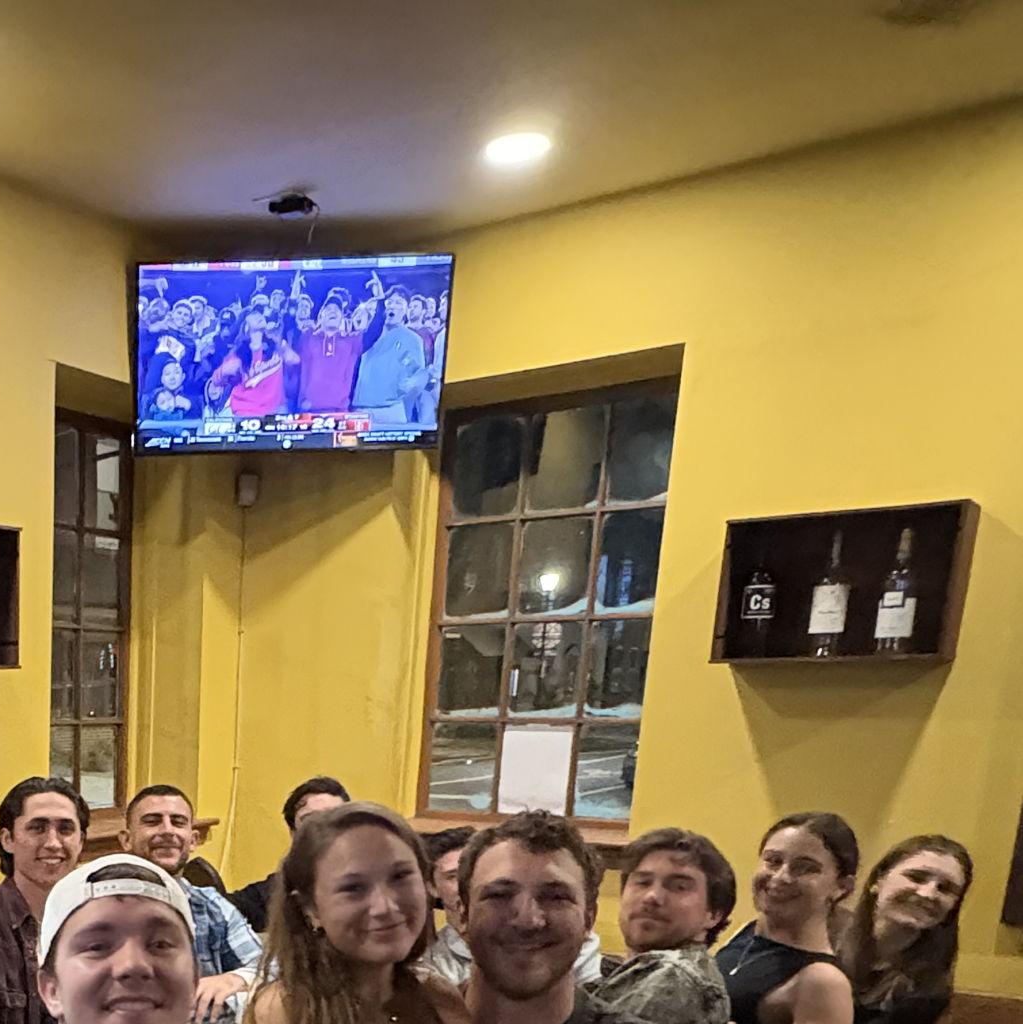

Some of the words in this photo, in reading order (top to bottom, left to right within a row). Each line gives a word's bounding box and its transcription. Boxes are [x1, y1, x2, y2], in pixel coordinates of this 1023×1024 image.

[240, 418, 261, 431] 10
[311, 417, 336, 430] 24
[749, 594, 771, 610] Cs
